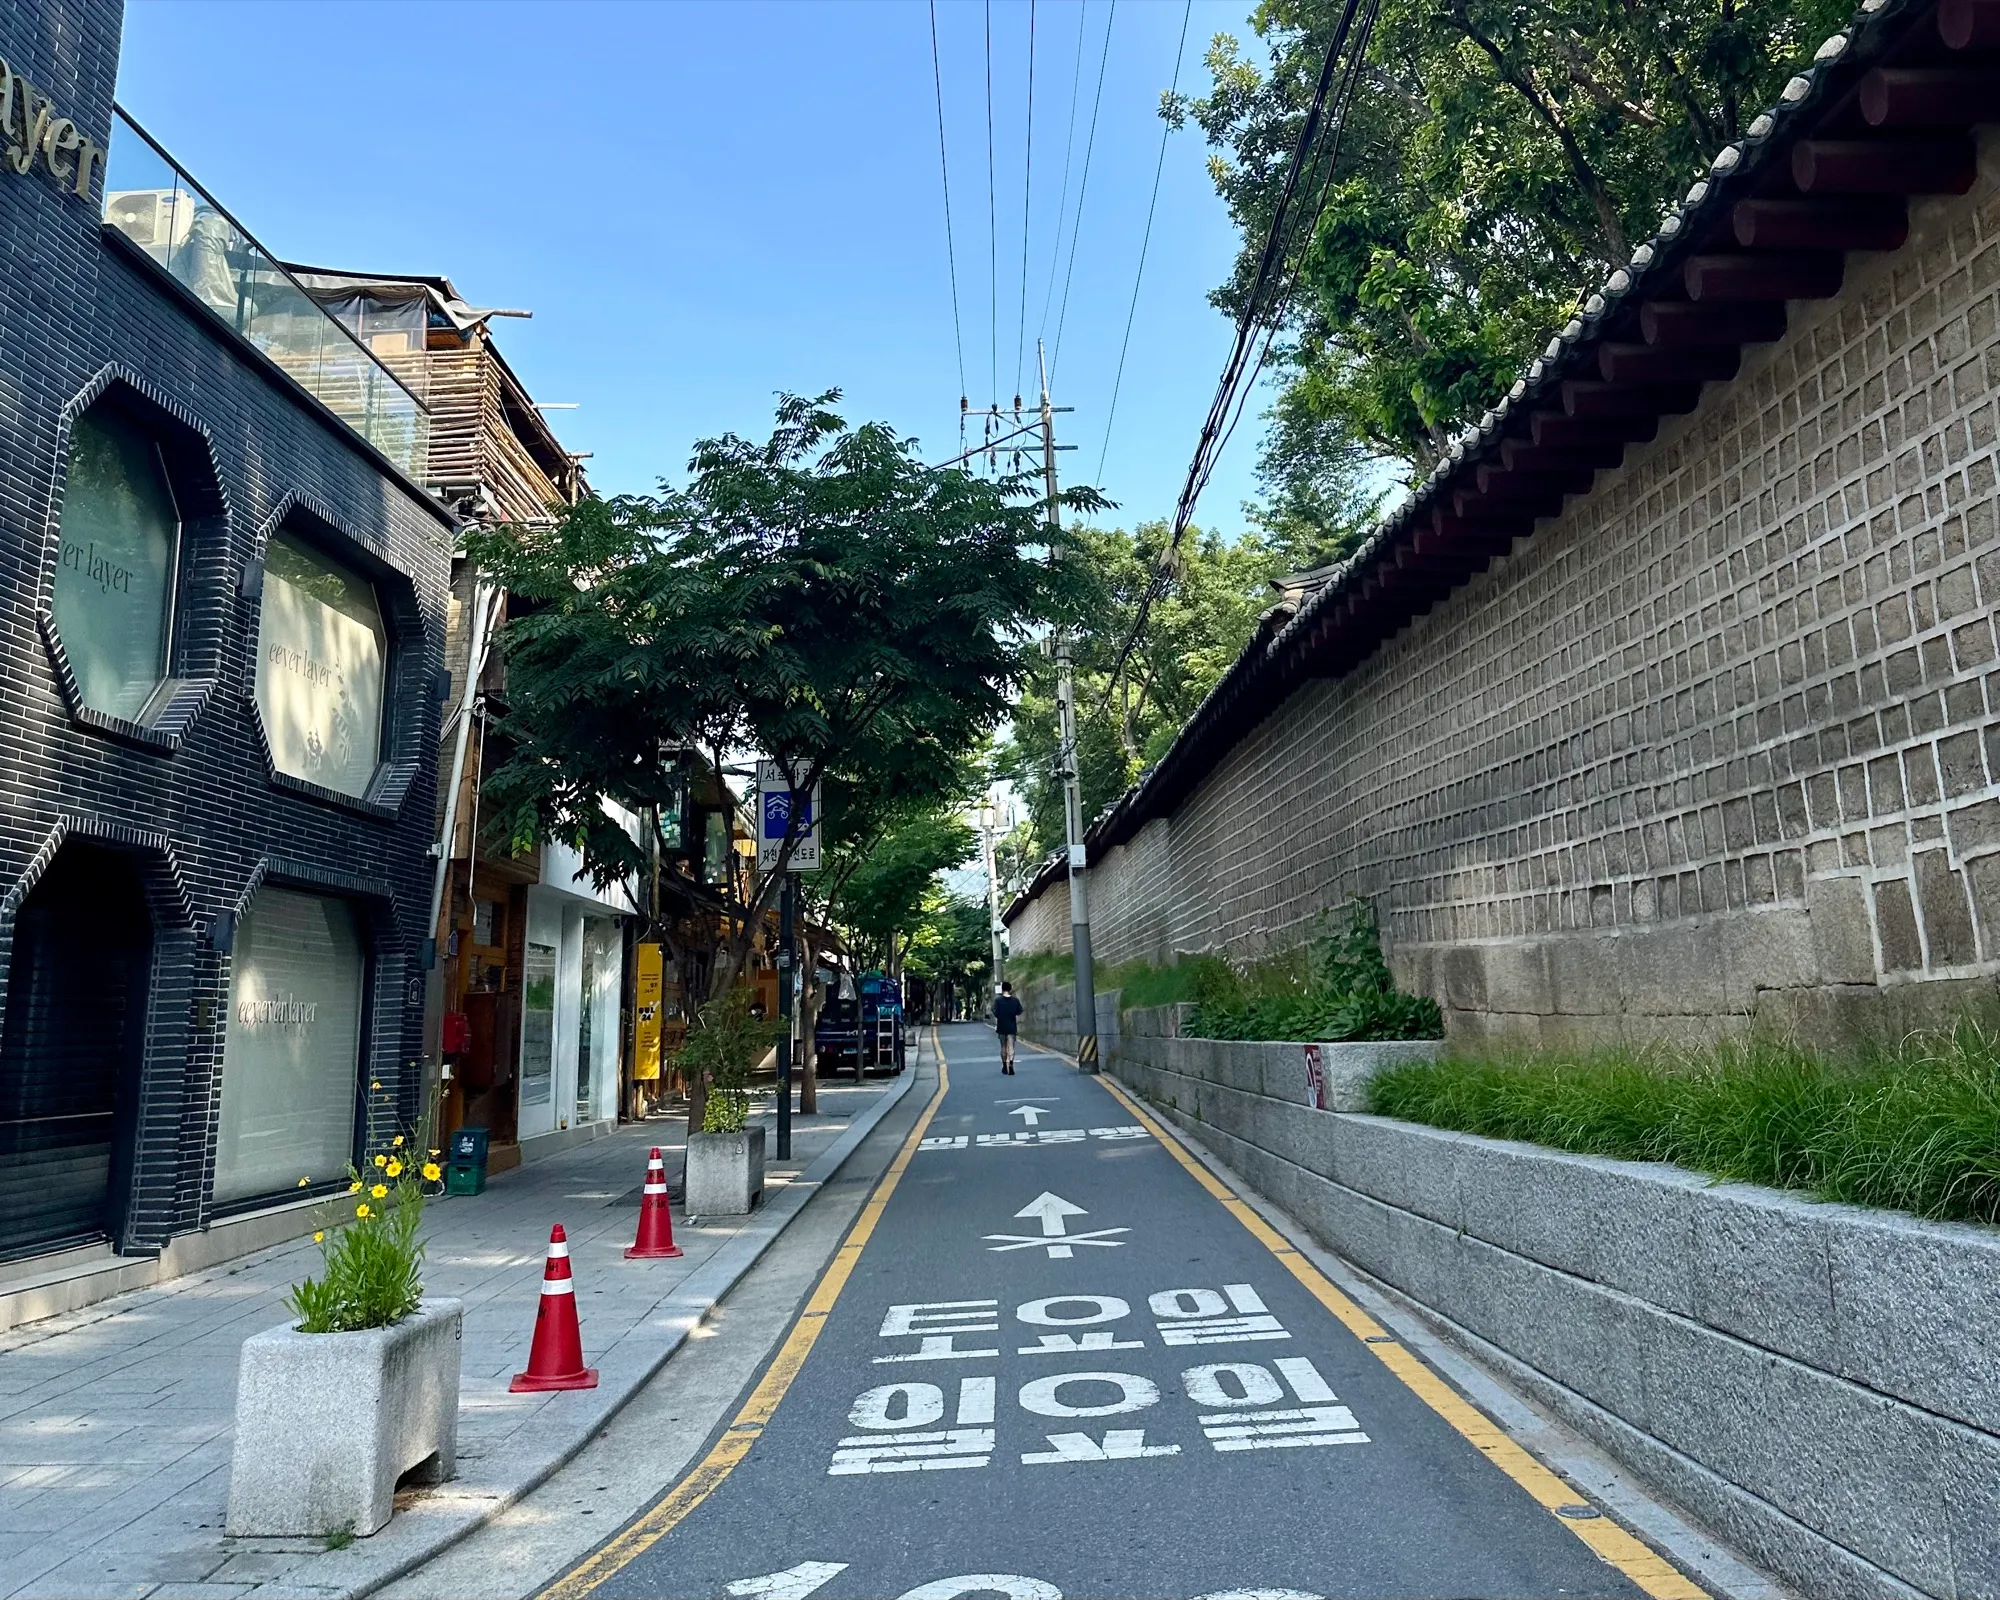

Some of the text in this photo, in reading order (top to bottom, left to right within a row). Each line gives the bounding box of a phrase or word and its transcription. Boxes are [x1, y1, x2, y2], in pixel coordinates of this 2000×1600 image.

[763, 848, 816, 863] 자전선도로
[638, 1006, 655, 1014] SUL
[641, 1013, 652, 1021] 24
[917, 1125, 1151, 1151] 일방통행
[872, 1283, 1292, 1363] 토요일
[827, 1356, 1372, 1476] 일요일
